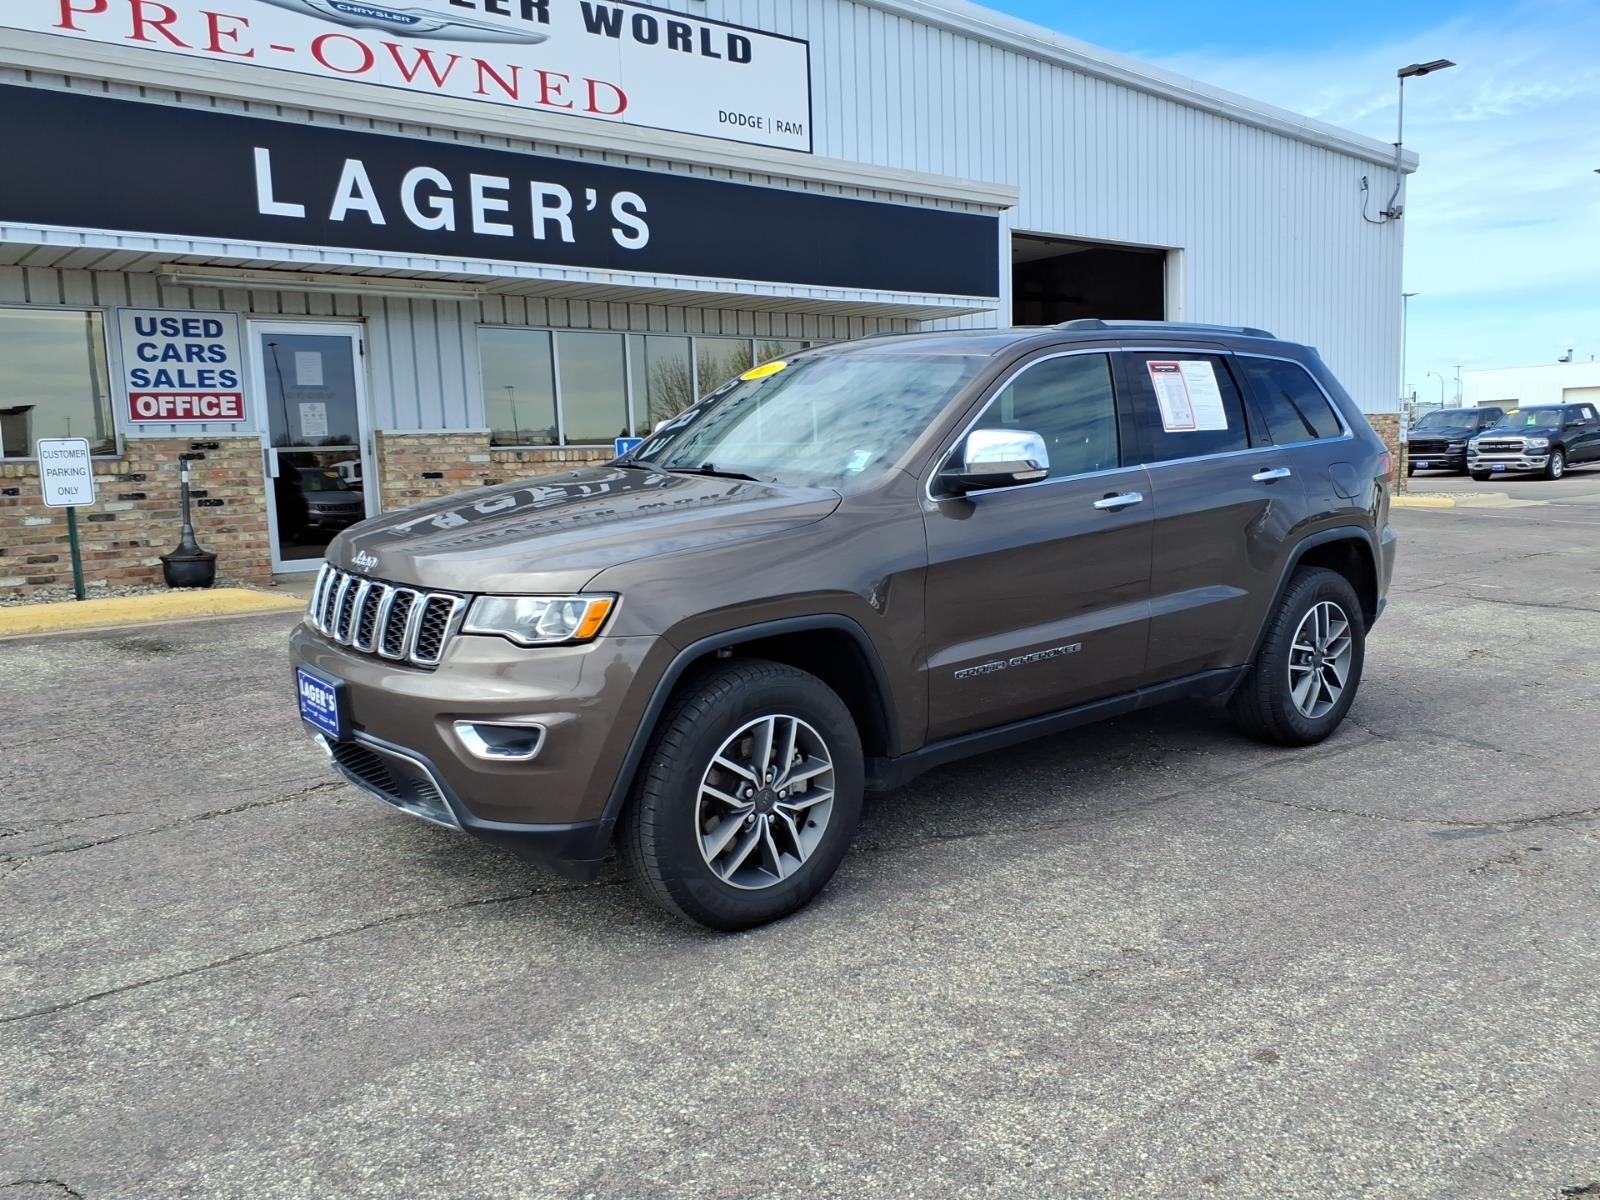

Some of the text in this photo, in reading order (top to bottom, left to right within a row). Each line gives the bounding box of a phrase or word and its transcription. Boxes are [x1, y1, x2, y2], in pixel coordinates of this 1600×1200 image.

[336, 4, 412, 24] CHRYSLER
[579, 1, 752, 64] WORLD
[51, 0, 628, 116] PRE-OWNED
[718, 110, 803, 136] DODGE RAM
[253, 147, 650, 250] LAGER'S
[134, 317, 224, 339] USED
[136, 343, 227, 363] CARS
[130, 368, 238, 389] SALES
[136, 396, 238, 416] OFFICE
[42, 449, 86, 459] CUSTOMER
[46, 468, 86, 477] PARKING
[57, 486, 79, 496] ONLY
[954, 642, 1082, 680] GRAND CHEROKEE
[300, 678, 335, 712] LAGER'S
